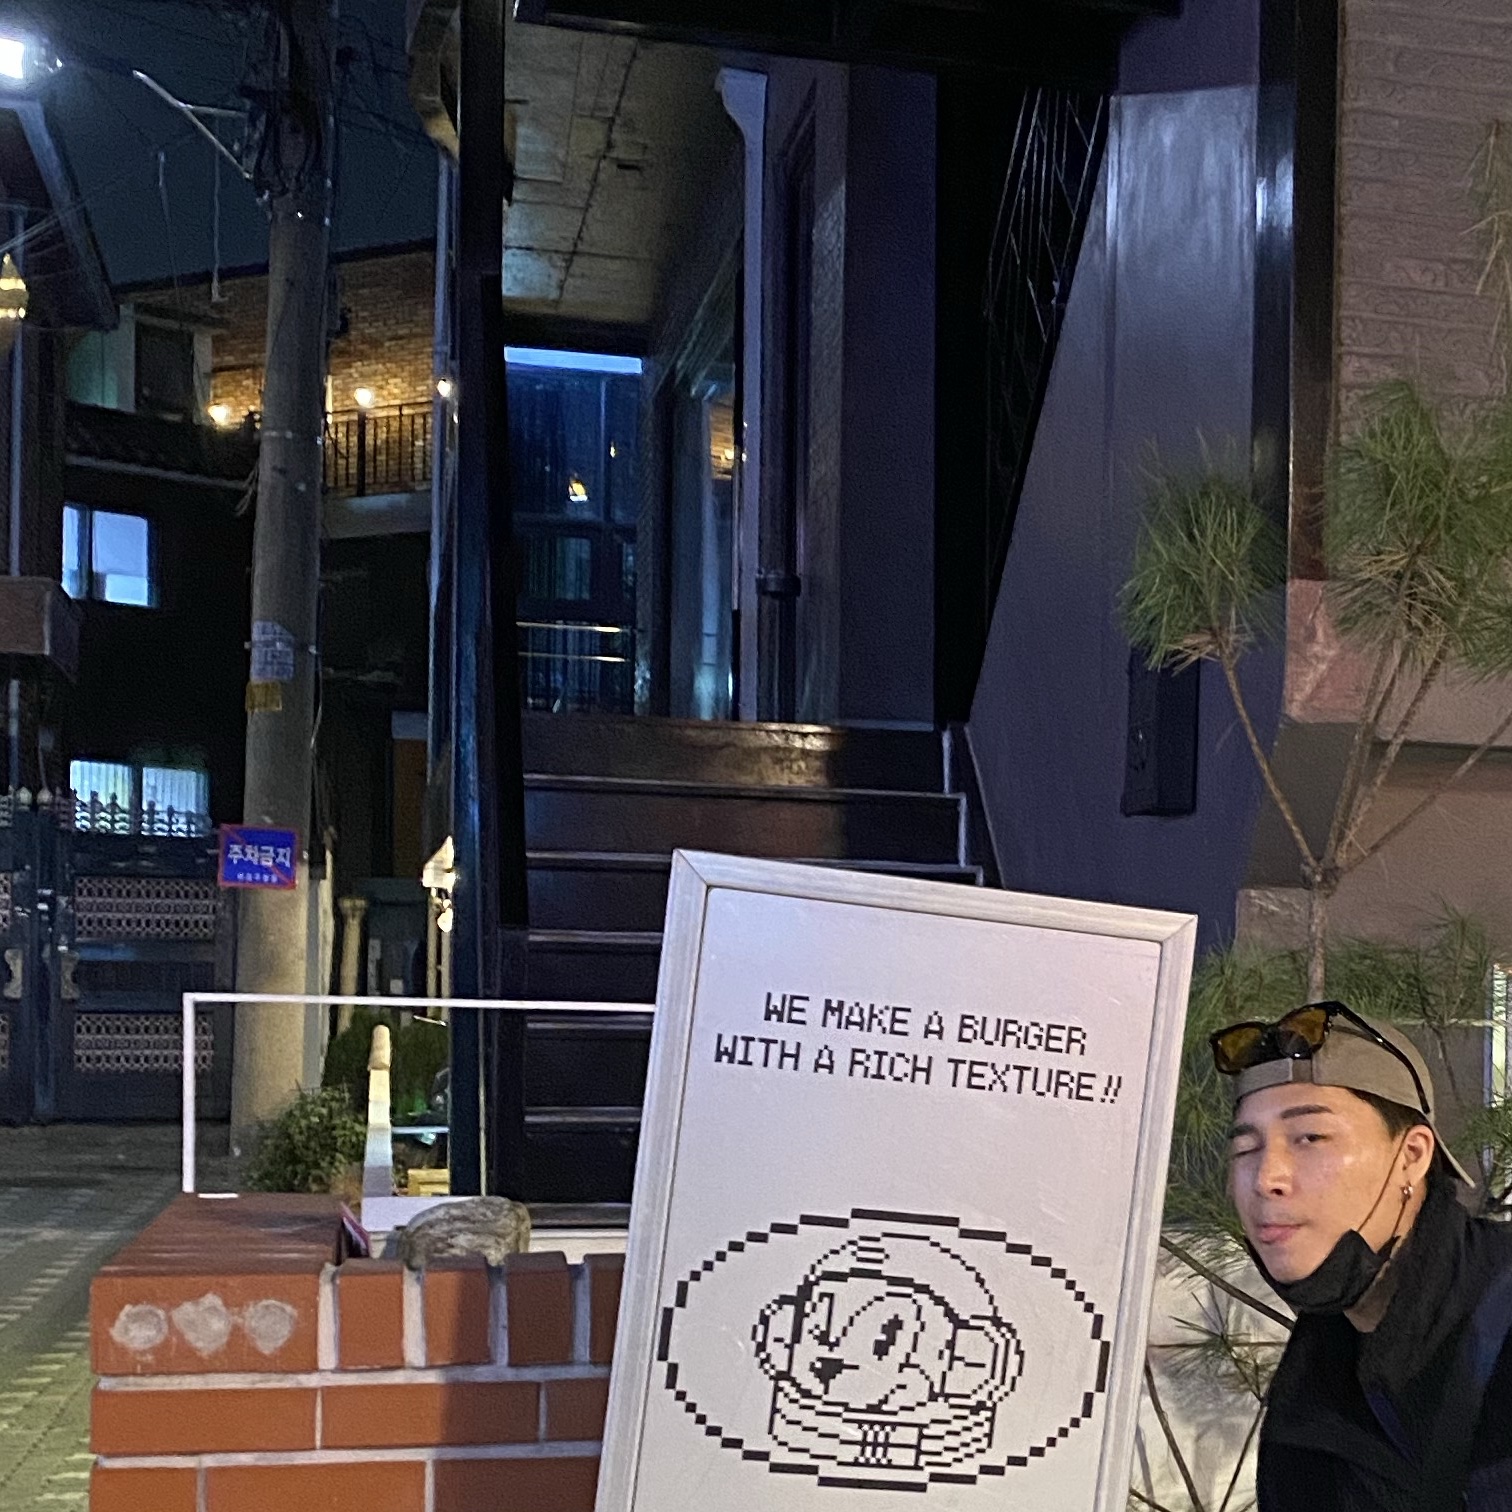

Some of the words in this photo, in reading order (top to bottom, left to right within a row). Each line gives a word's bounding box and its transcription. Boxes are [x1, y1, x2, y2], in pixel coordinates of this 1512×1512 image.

[228, 844, 291, 868] 주차금지
[763, 991, 810, 1026] WE
[821, 998, 912, 1037] MAKE
[923, 1010, 945, 1041] A
[957, 1014, 1087, 1056] BURGER
[714, 1033, 802, 1072] WITH
[813, 1044, 835, 1075] A
[848, 1047, 933, 1085] RICH
[947, 1057, 1123, 1105] TEXTURE!!
